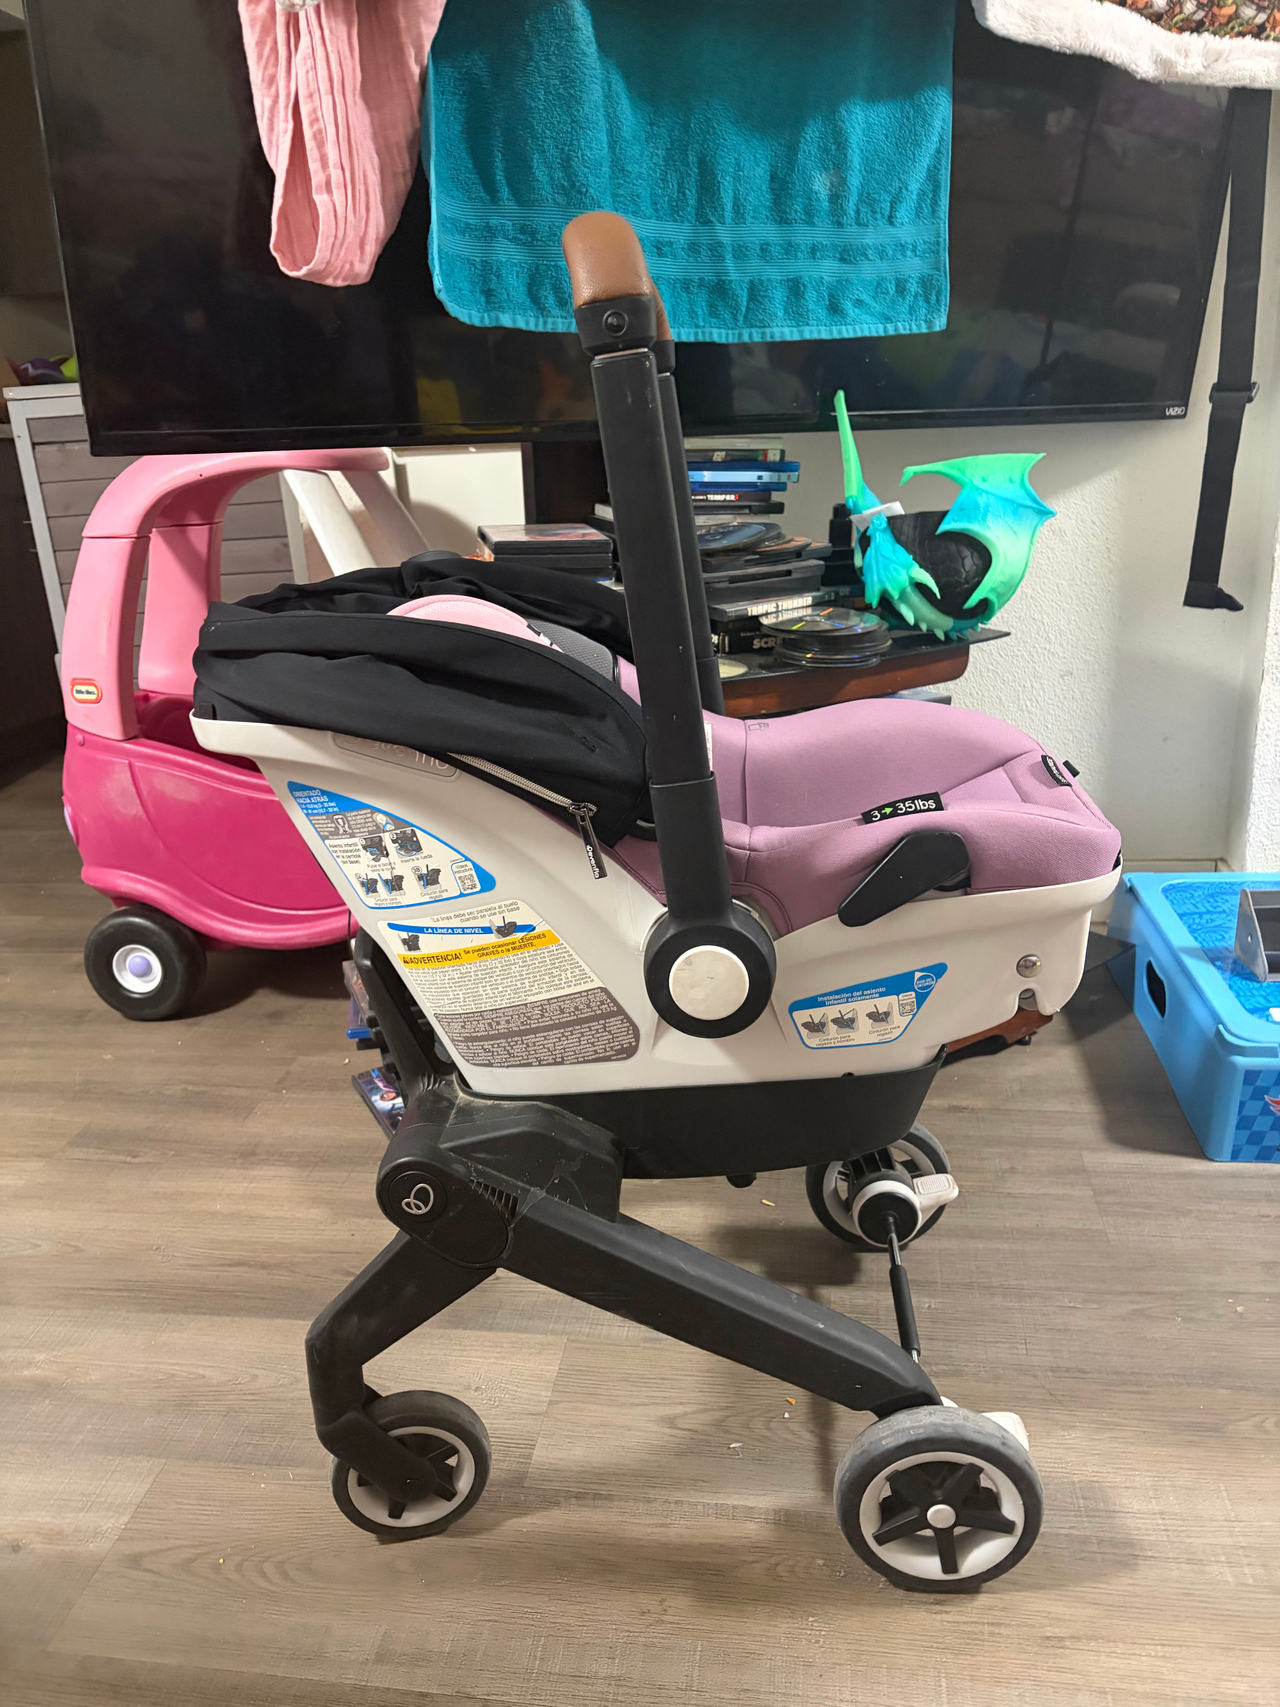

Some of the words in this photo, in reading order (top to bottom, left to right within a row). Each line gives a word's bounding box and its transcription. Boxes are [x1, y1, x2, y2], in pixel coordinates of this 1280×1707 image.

[1166, 406, 1186, 416] VIZIO
[747, 602, 776, 616] TROPIC
[778, 596, 813, 611] THUNDER
[870, 810, 881, 821] 3
[895, 798, 936, 814] 35lbs
[460, 915, 480, 923] cuando
[434, 926, 453, 934] LÍNEA
[471, 945, 490, 954] pueden
[492, 940, 517, 949] ocasionar
[518, 933, 547, 944] LESIONES
[477, 950, 500, 958] GRAVES
[818, 991, 851, 1002] Instalación
[863, 987, 886, 995] asiento
[848, 993, 880, 1002] solamente
